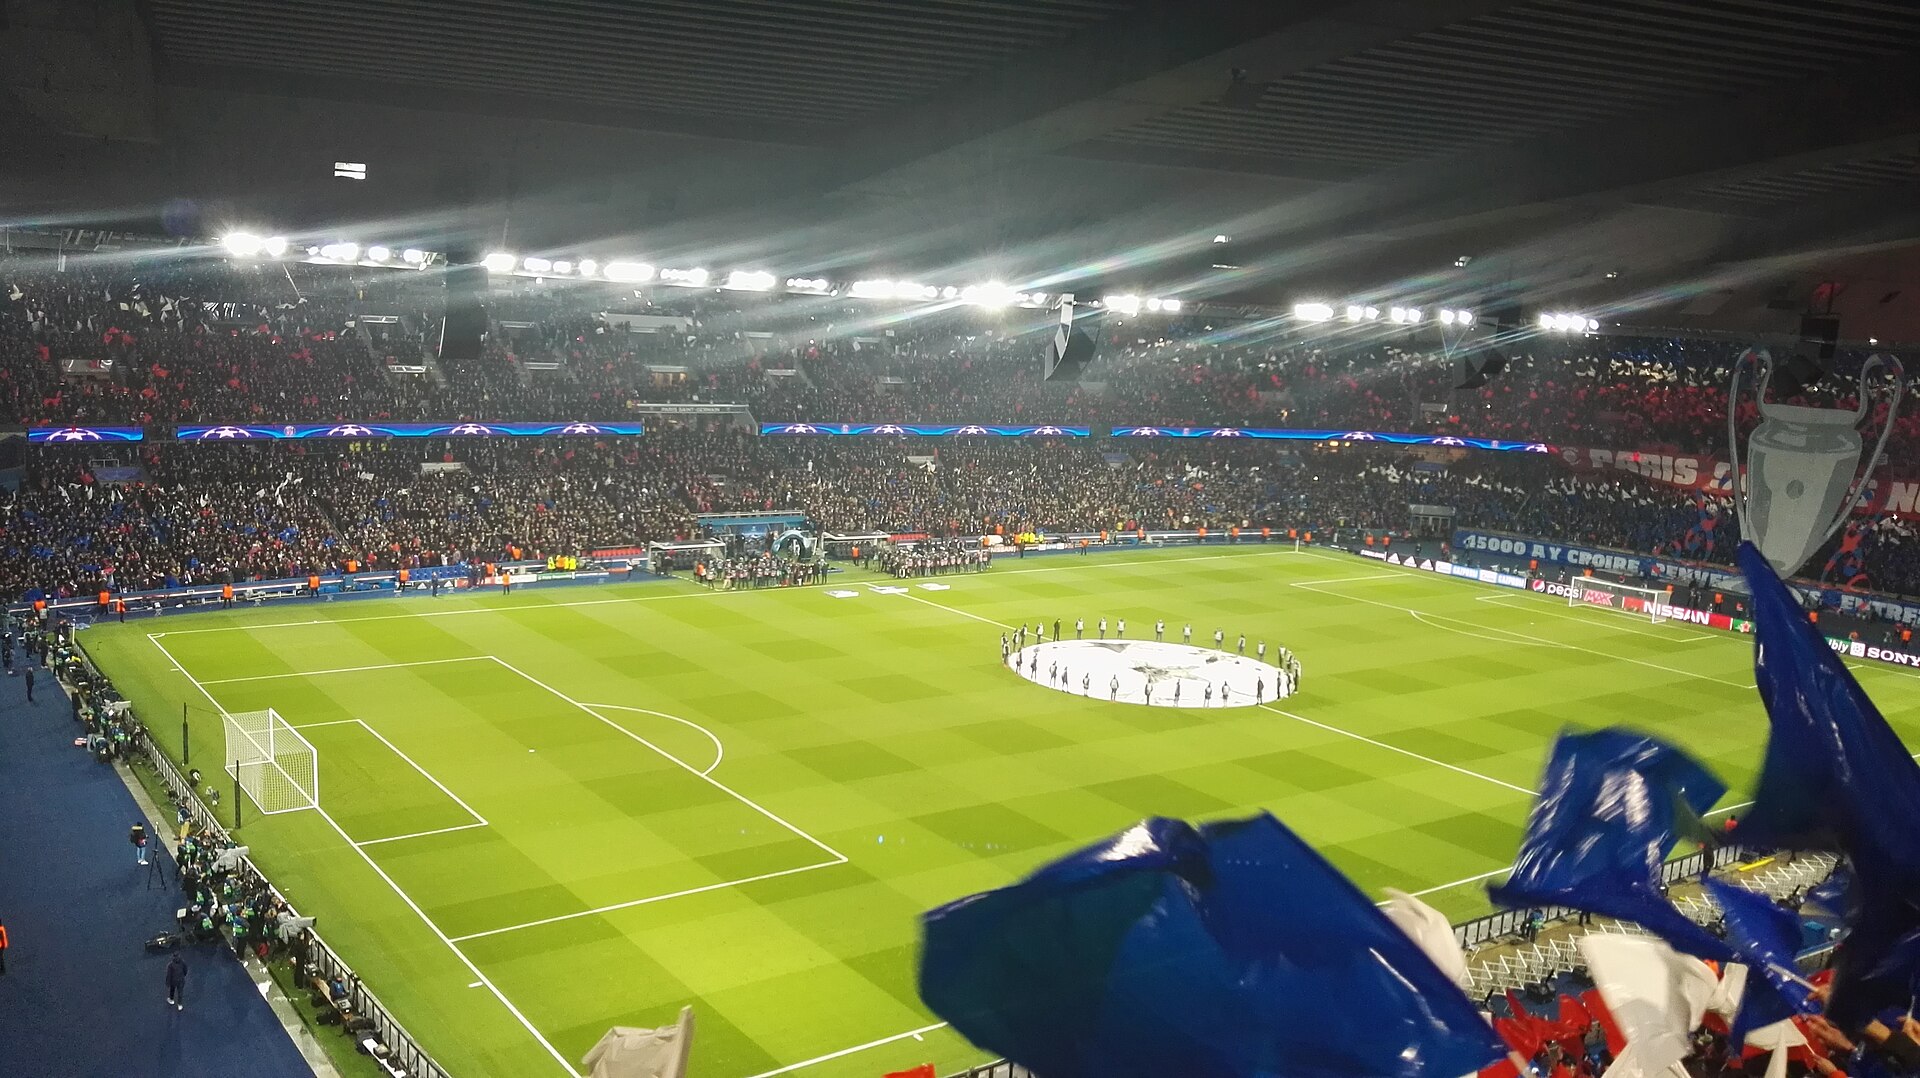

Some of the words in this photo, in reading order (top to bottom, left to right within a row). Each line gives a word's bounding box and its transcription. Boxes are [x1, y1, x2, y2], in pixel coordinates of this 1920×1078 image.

[1589, 448, 1699, 485] PARIS
[1549, 547, 1562, 561] Y
[1547, 584, 1583, 599] pepsi
[1584, 588, 1615, 606] MAX
[1643, 601, 1710, 625] NISSAN
[1867, 647, 1920, 667] SONY
